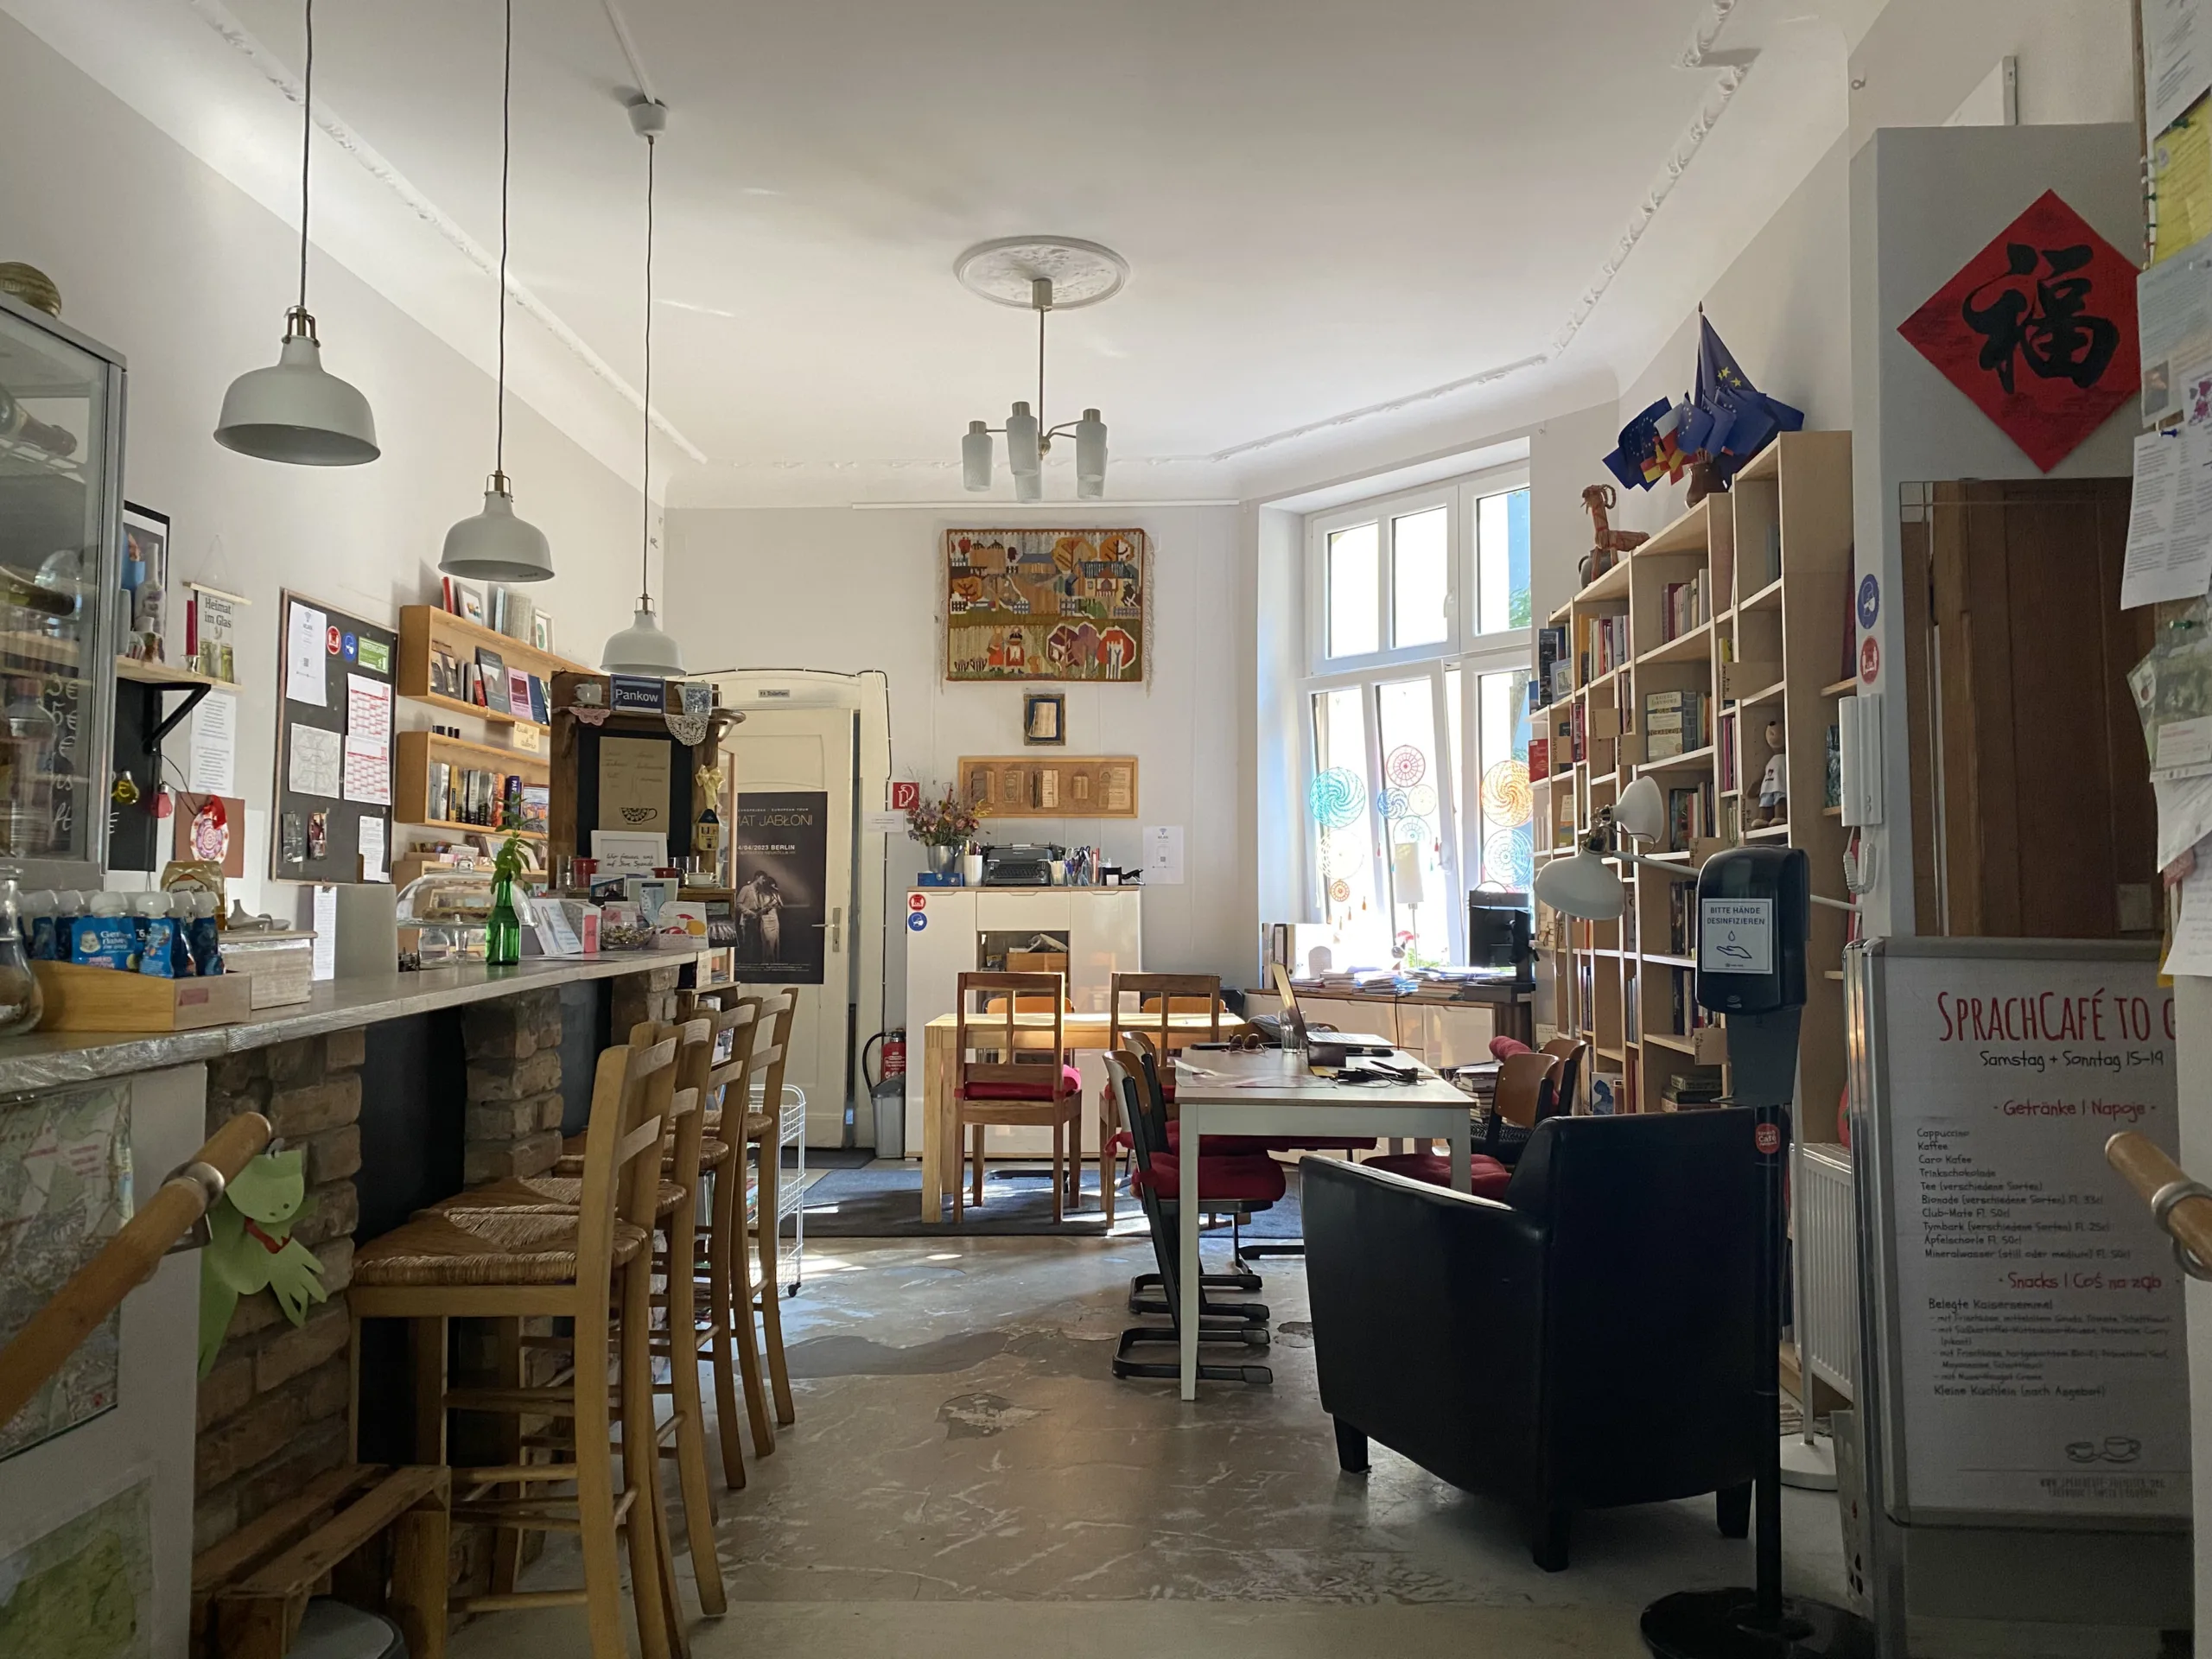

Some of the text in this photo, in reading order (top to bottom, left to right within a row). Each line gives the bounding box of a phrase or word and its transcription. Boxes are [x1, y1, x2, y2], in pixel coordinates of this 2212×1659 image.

[1961, 242, 2120, 394] 福
[205, 597, 232, 614] Heimat
[204, 611, 232, 628] im Glas
[615, 689, 658, 702] Pankow
[759, 814, 813, 827] JABŁONI
[1732, 905, 1761, 914] HÄNDE
[1707, 917, 1765, 925] DESINFIZIEREN
[2113, 996, 2152, 1042] TO
[1980, 1050, 2045, 1072] Samstag
[2049, 1055, 2059, 1065] +
[2063, 1050, 2122, 1072] Sonntag
[2003, 1098, 2076, 1116] Getränke
[2091, 1098, 2146, 1123] Napoje
[1916, 1128, 1970, 1141] Cappuccino
[1917, 1141, 1948, 1151] Kaffee
[1918, 1154, 1942, 1165] Caro
[1918, 1167, 1997, 1178] Trinkschokolade
[1920, 1181, 1936, 1191] Tee
[1921, 1194, 1959, 1205] Bionade
[1961, 1194, 2026, 1205] (verschiedene
[1922, 1208, 1973, 1218] Club-Mate
[1923, 1221, 1965, 1234] Tymbark
[1924, 1249, 1994, 1259] Mineralwasser
[2007, 1272, 2059, 1288] Snacks
[2073, 1271, 2104, 1289] Coś
[2108, 1278, 2126, 1289] na
[1928, 1298, 2053, 1314] Belegte Kaisersemmel
[1941, 1337, 1973, 1346] (pikant)
[1934, 1384, 1967, 1396] Kleine
